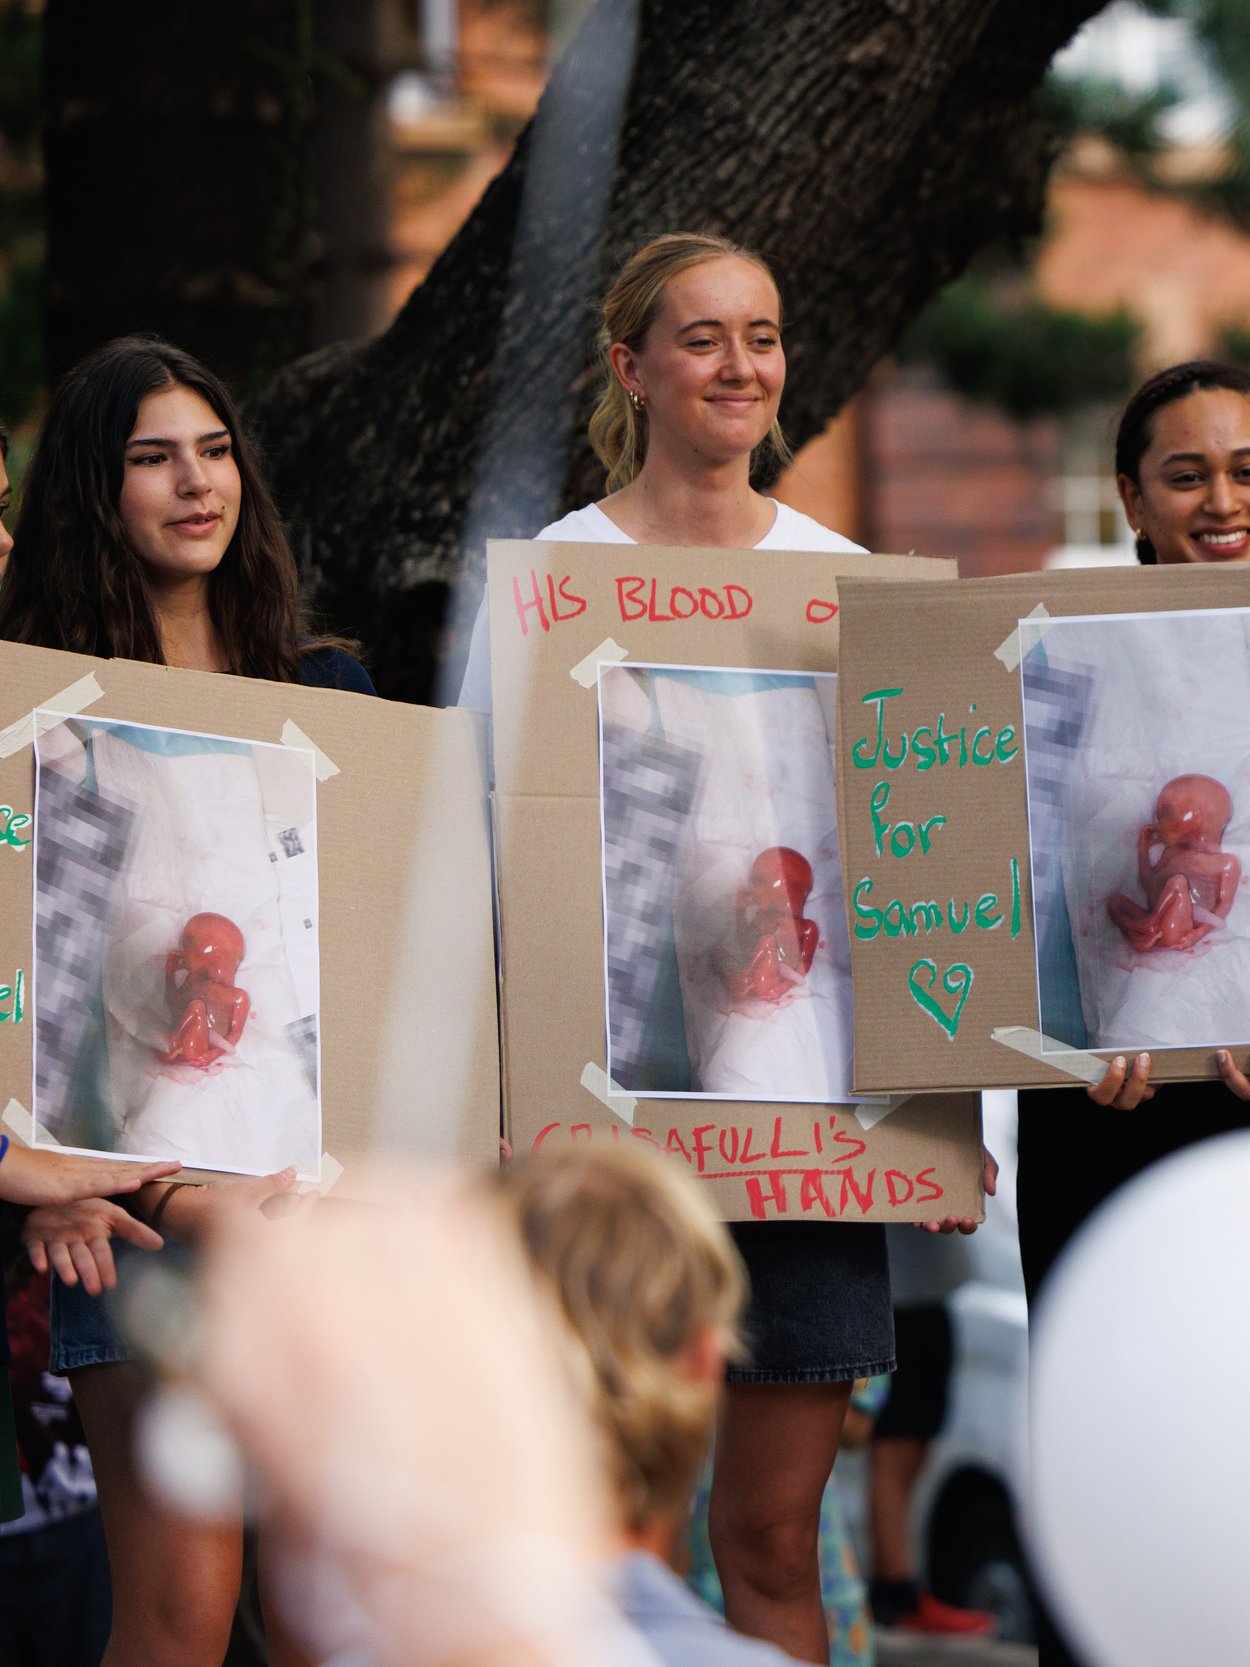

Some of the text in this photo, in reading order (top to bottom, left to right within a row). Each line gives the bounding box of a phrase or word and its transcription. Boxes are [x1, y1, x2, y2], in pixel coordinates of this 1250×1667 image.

[512, 569, 587, 637] HIS
[614, 576, 753, 622] BLOOD
[852, 687, 1019, 771] Justice
[870, 780, 947, 859] for
[853, 857, 1021, 941] Samuel
[744, 1166, 944, 1219] HANDS
